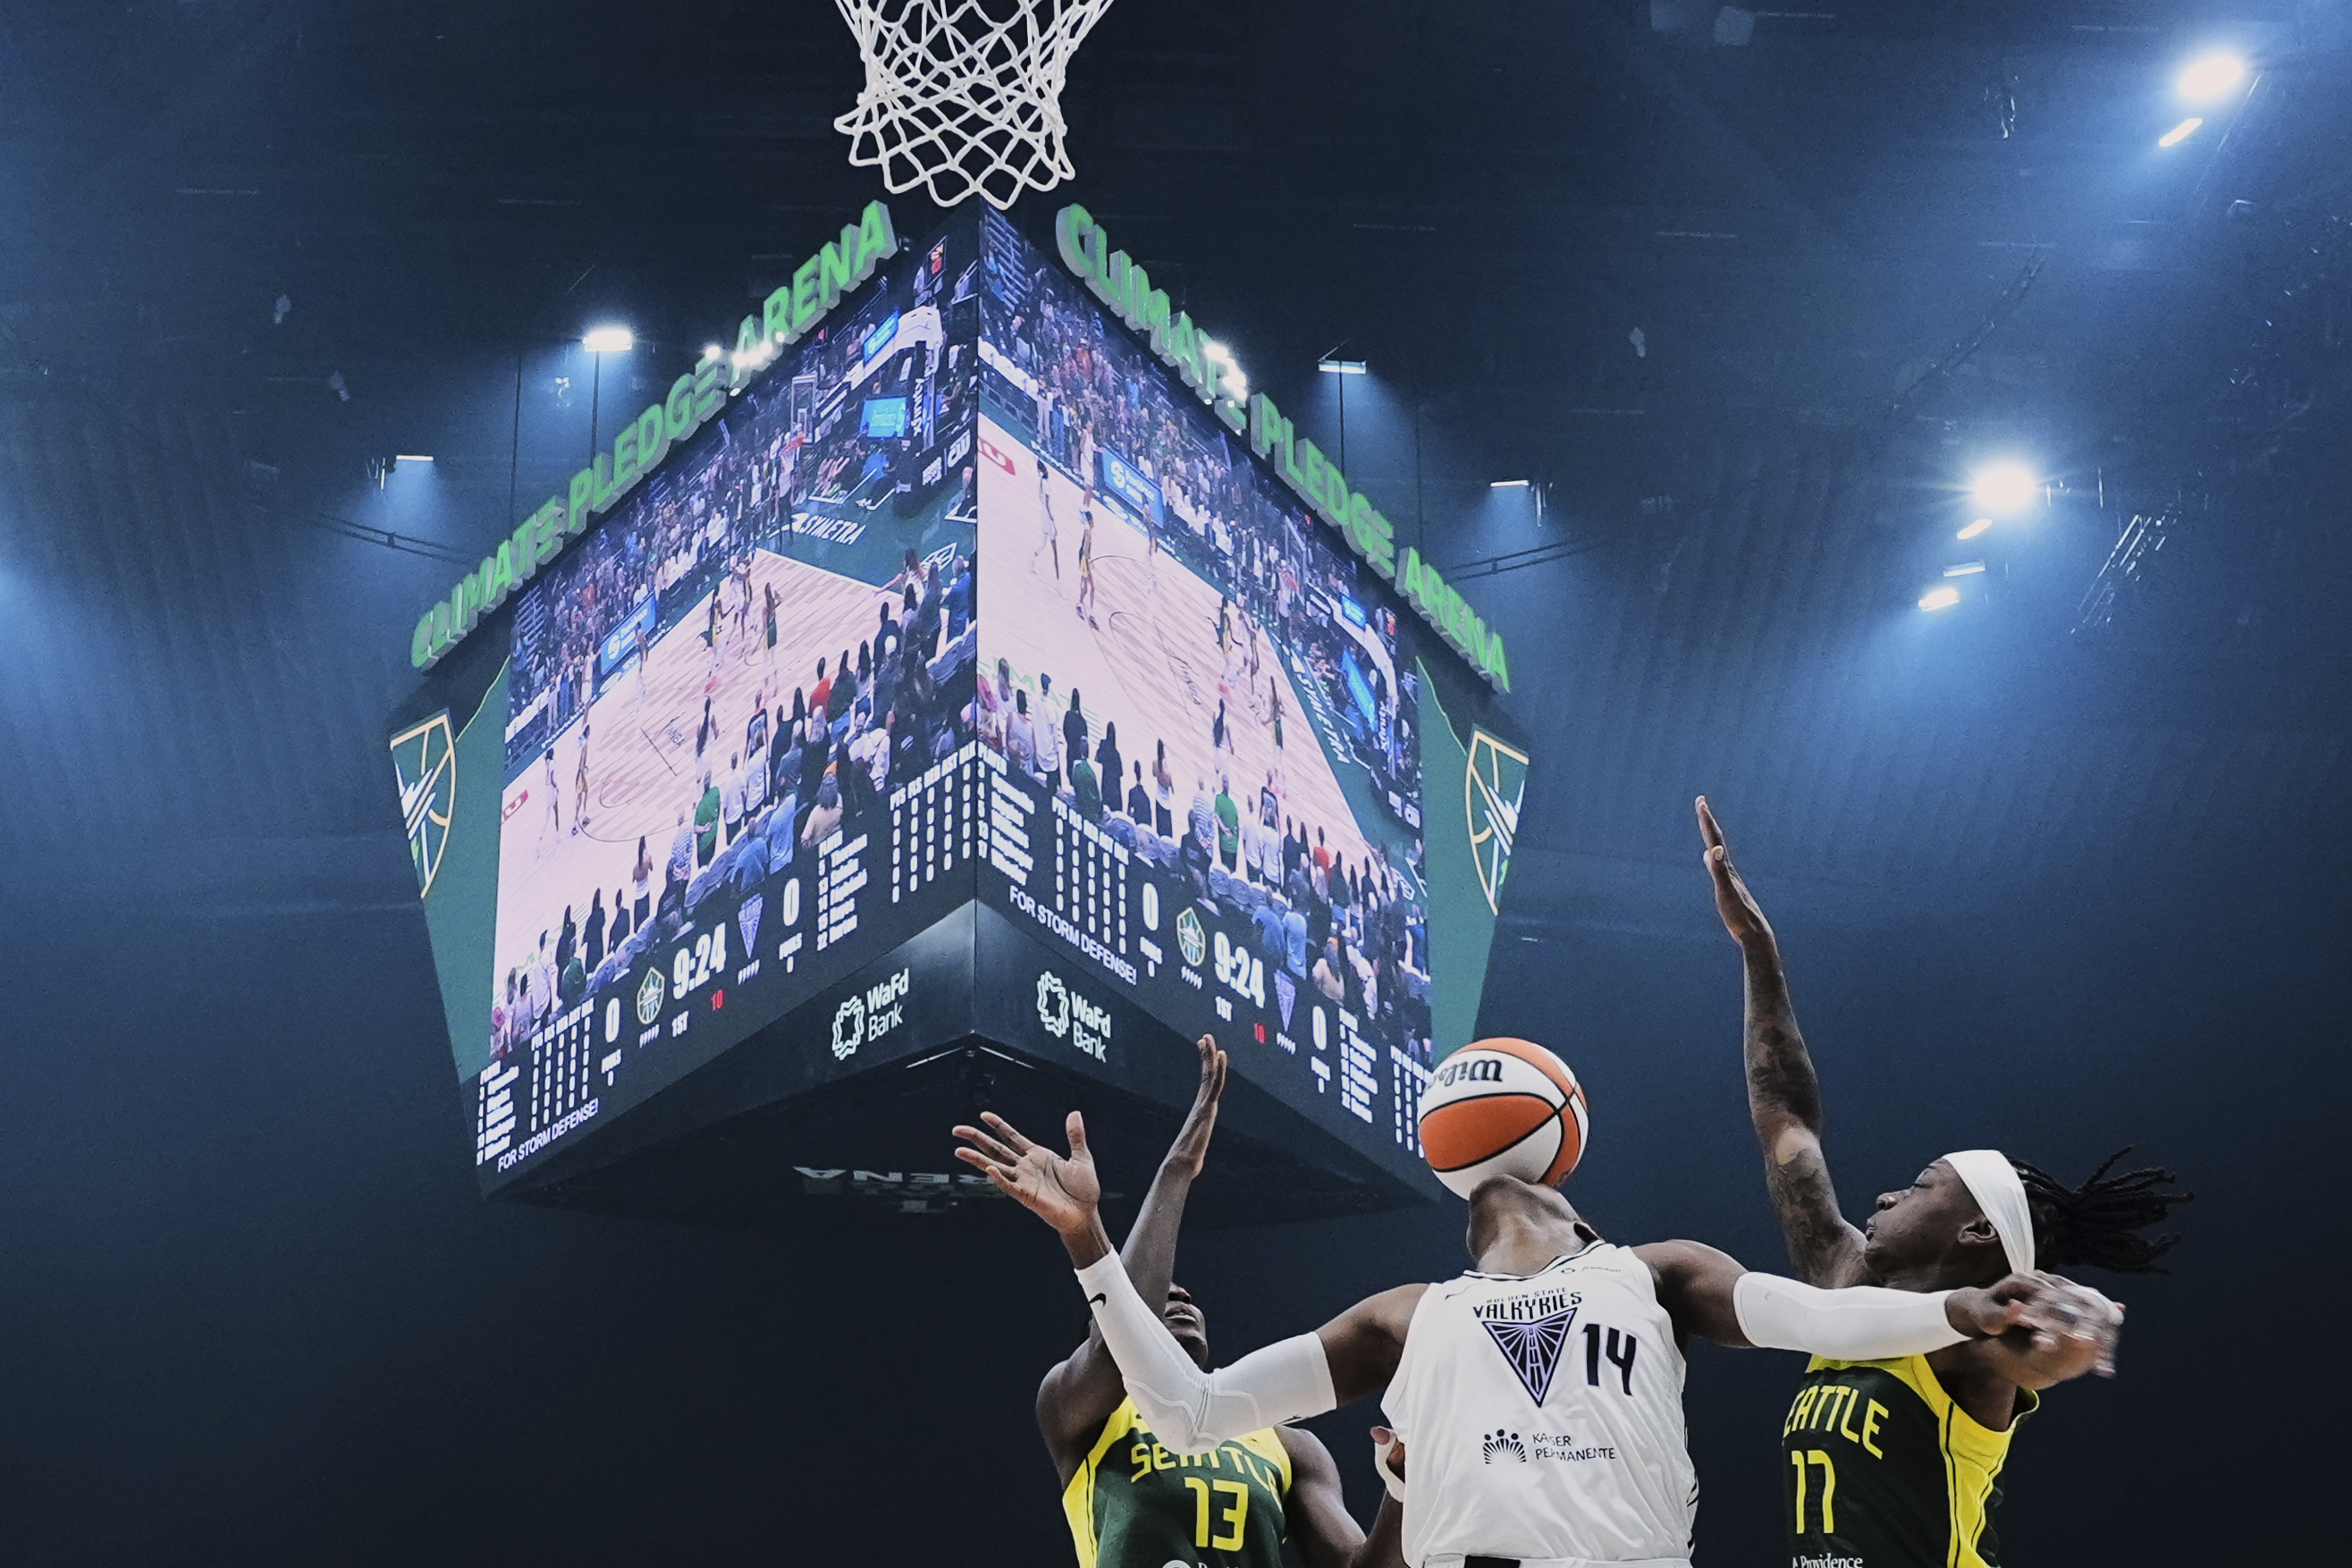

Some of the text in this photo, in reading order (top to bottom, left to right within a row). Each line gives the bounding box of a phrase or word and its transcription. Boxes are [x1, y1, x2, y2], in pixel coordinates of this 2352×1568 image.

[410, 199, 898, 670] CLIMATE PLEDGE ARENA
[802, 515, 866, 545] SYMETRA
[1251, 392, 1395, 581] PLEDGE
[1394, 546, 1511, 693] ARENA
[890, 788, 906, 810] PTS
[783, 877, 800, 926] 0
[1142, 882, 1159, 932] 0
[1010, 886, 1136, 984] FOR STORM DEFENSE!
[673, 923, 726, 999] 9:24
[1214, 932, 1265, 1008] 9:24
[711, 989, 724, 1011] 10
[867, 968, 908, 1013] WaFd
[605, 998, 620, 1043] 0
[671, 1010, 689, 1038] 1ST
[868, 1002, 903, 1041] Bank
[1071, 991, 1111, 1039] WaFd
[1311, 1006, 1328, 1050] 0
[1073, 1020, 1107, 1063] Bank
[498, 1149, 517, 1173] FOR
[518, 1128, 550, 1159] STORM
[552, 1098, 598, 1140] DEFENSE!
[792, 1166, 995, 1185] RENA
[1472, 1291, 1582, 1320] VALKYRIES
[1533, 1286, 1568, 1298] STATE
[1581, 1323, 1637, 1396] 14
[1783, 1385, 1889, 1460] EATTLE
[1184, 1476, 1249, 1552] 13
[1791, 1449, 1836, 1534] 17
[1800, 1552, 1863, 1568] Providence
